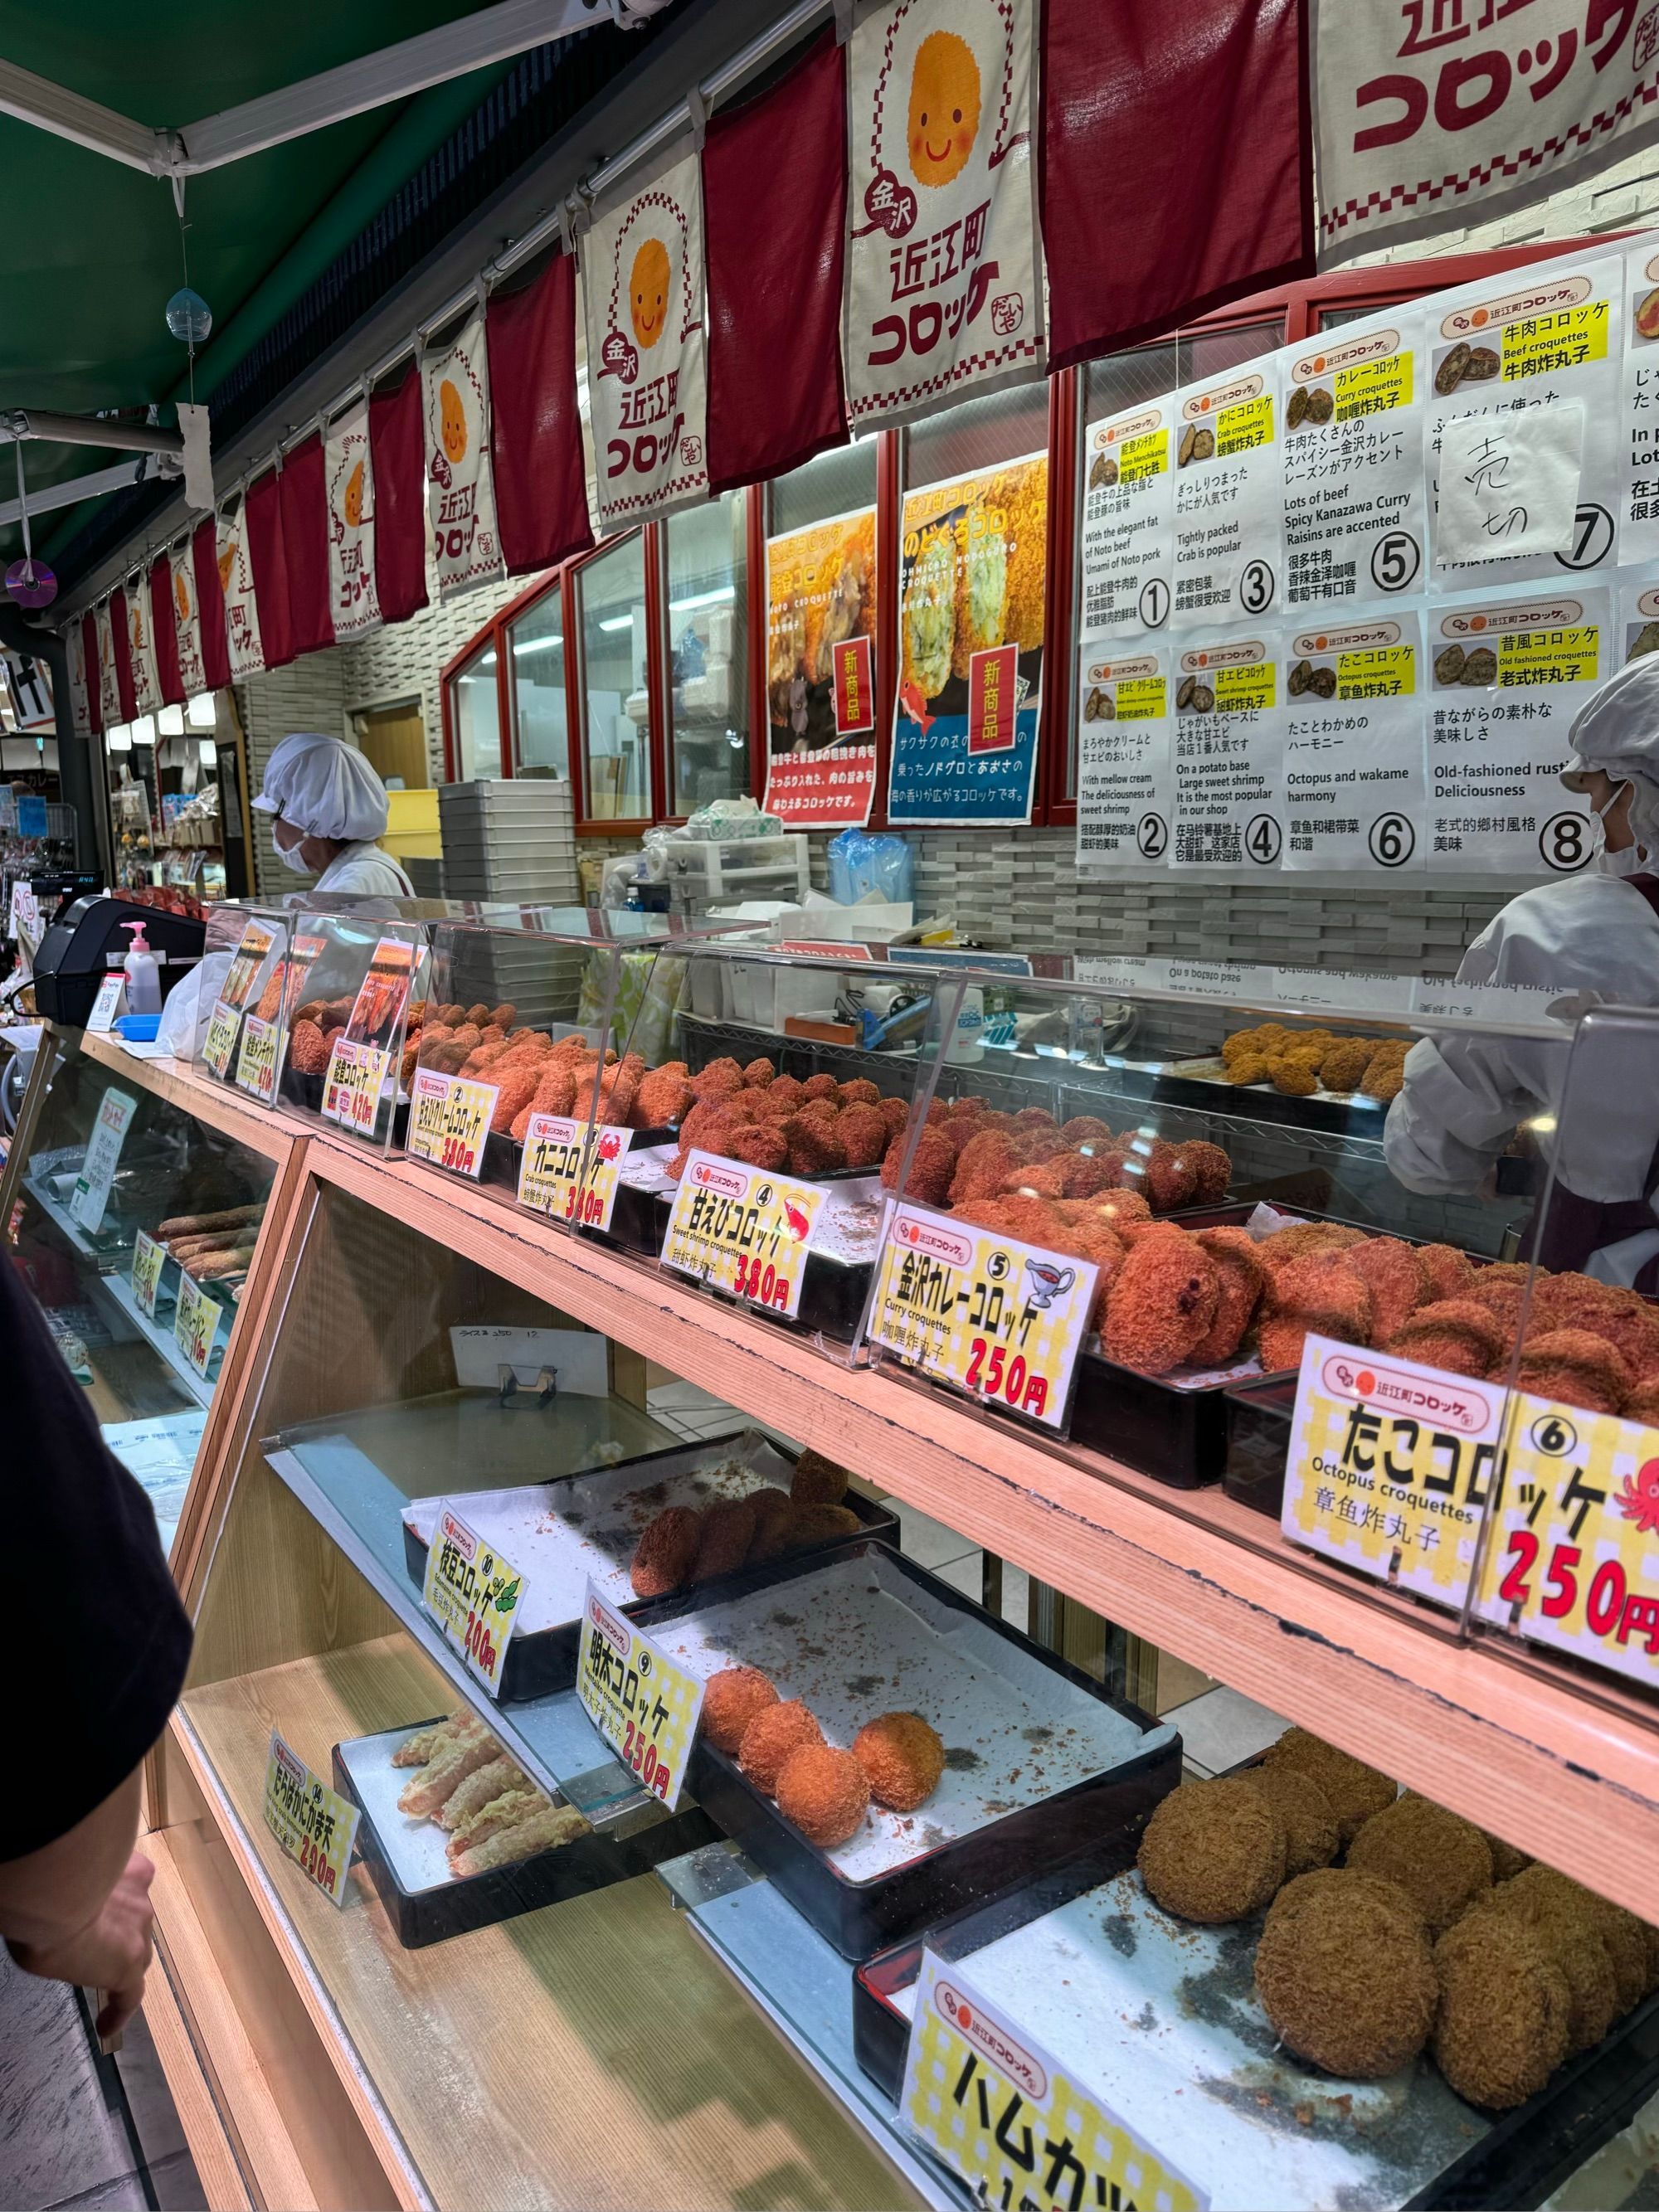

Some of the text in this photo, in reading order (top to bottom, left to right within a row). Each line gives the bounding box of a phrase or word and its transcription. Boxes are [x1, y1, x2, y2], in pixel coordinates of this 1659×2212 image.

[869, 179, 912, 231] 金沢
[891, 199, 991, 302] 近江町
[868, 261, 999, 366] コロッケ
[1505, 303, 1608, 342] 牛肉コロッケ
[1504, 331, 1588, 359] Beef croquettes
[1337, 357, 1400, 387] カレーコロッケ
[1505, 345, 1589, 382] 牛肉炸丸子
[619, 369, 680, 430] 近江町
[1336, 377, 1403, 402] Curry croquettes
[1219, 396, 1273, 425] かにコロッケ
[1218, 420, 1264, 439] Crab croquettes
[1285, 420, 1364, 452] 牛肉たくさんの
[607, 413, 684, 478] コロッケ
[1285, 431, 1404, 469] スパイシー金沢カレー
[1286, 445, 1403, 484] レーズンがアクセント
[1178, 468, 1248, 497] ぎっしりつまった
[1177, 487, 1238, 513] かにが人気です
[1285, 484, 1349, 510] Lots of beef
[1286, 493, 1411, 529] Spicy Kanazawa Curry
[904, 499, 1046, 557] のどぐろコロッケ
[1086, 517, 1158, 542] With the elegant fat
[1178, 521, 1238, 547] Tightly packed
[1287, 512, 1400, 546] Raisins are accented
[1086, 539, 1131, 558] of Noto beef
[1178, 541, 1241, 562] Crab is popular
[1288, 549, 1331, 571] 很多牛肉
[1086, 549, 1160, 574] Umami of Noto pork
[1288, 561, 1356, 587] 香辣金泽咖喱
[1288, 580, 1356, 604] 葡萄干有口音
[1501, 626, 1598, 651] 昔風コロッケ
[1340, 647, 1413, 668] たこコロッケ
[1515, 654, 1552, 664] fashioned
[1554, 649, 1597, 661] croquettes
[1338, 669, 1395, 681] Octopus croquettes
[1501, 664, 1581, 687] 老式炸丸子
[982, 659, 1000, 740] 新商品
[1178, 711, 1258, 730] じゃがいもベースに
[1288, 717, 1368, 735] たことわかめの
[1433, 702, 1552, 725] 昔ながらの素朴な
[1082, 733, 1151, 750] まろやかクリームと
[1176, 727, 1229, 743] 大きな甘エビ
[1288, 738, 1344, 750] ハーモニー
[1433, 726, 1489, 743] 美味しさ
[1082, 750, 1142, 764] 甘エビのおいしさ
[1176, 761, 1249, 775] On a potato base
[1082, 774, 1152, 785] With mellow cream
[1180, 775, 1264, 790] Large sweet shrimp
[1287, 768, 1408, 786] Octopus and wakame
[1434, 762, 1530, 778] Old-fashioned
[1082, 788, 1155, 800] The deliciousness of
[1177, 789, 1272, 803] It is the most popular
[1288, 791, 1335, 803] harmony
[1434, 785, 1525, 797] Deliciousness
[1081, 804, 1130, 816] sweet shrimp
[1180, 805, 1228, 816] in our shop
[1290, 838, 1313, 851] 和谐
[1433, 837, 1462, 852] 美味
[526, 1174, 557, 1189] Crab croquettes
[673, 1224, 742, 1259] Sweet shrimp croquettes
[734, 1254, 790, 1311] 380円
[897, 1250, 1039, 1349] 金沢カレーコロッケ
[884, 1297, 951, 1335] Curry croquettes
[966, 1338, 1048, 1417] 250円
[1311, 1456, 1474, 1525] Octopus croquettes
[1314, 1486, 1441, 1553] 章鱼炸丸子
[1499, 1529, 1659, 1655] 250円
[590, 1628, 669, 1739] 明太コロッケ
[623, 1720, 670, 1800] 250円
